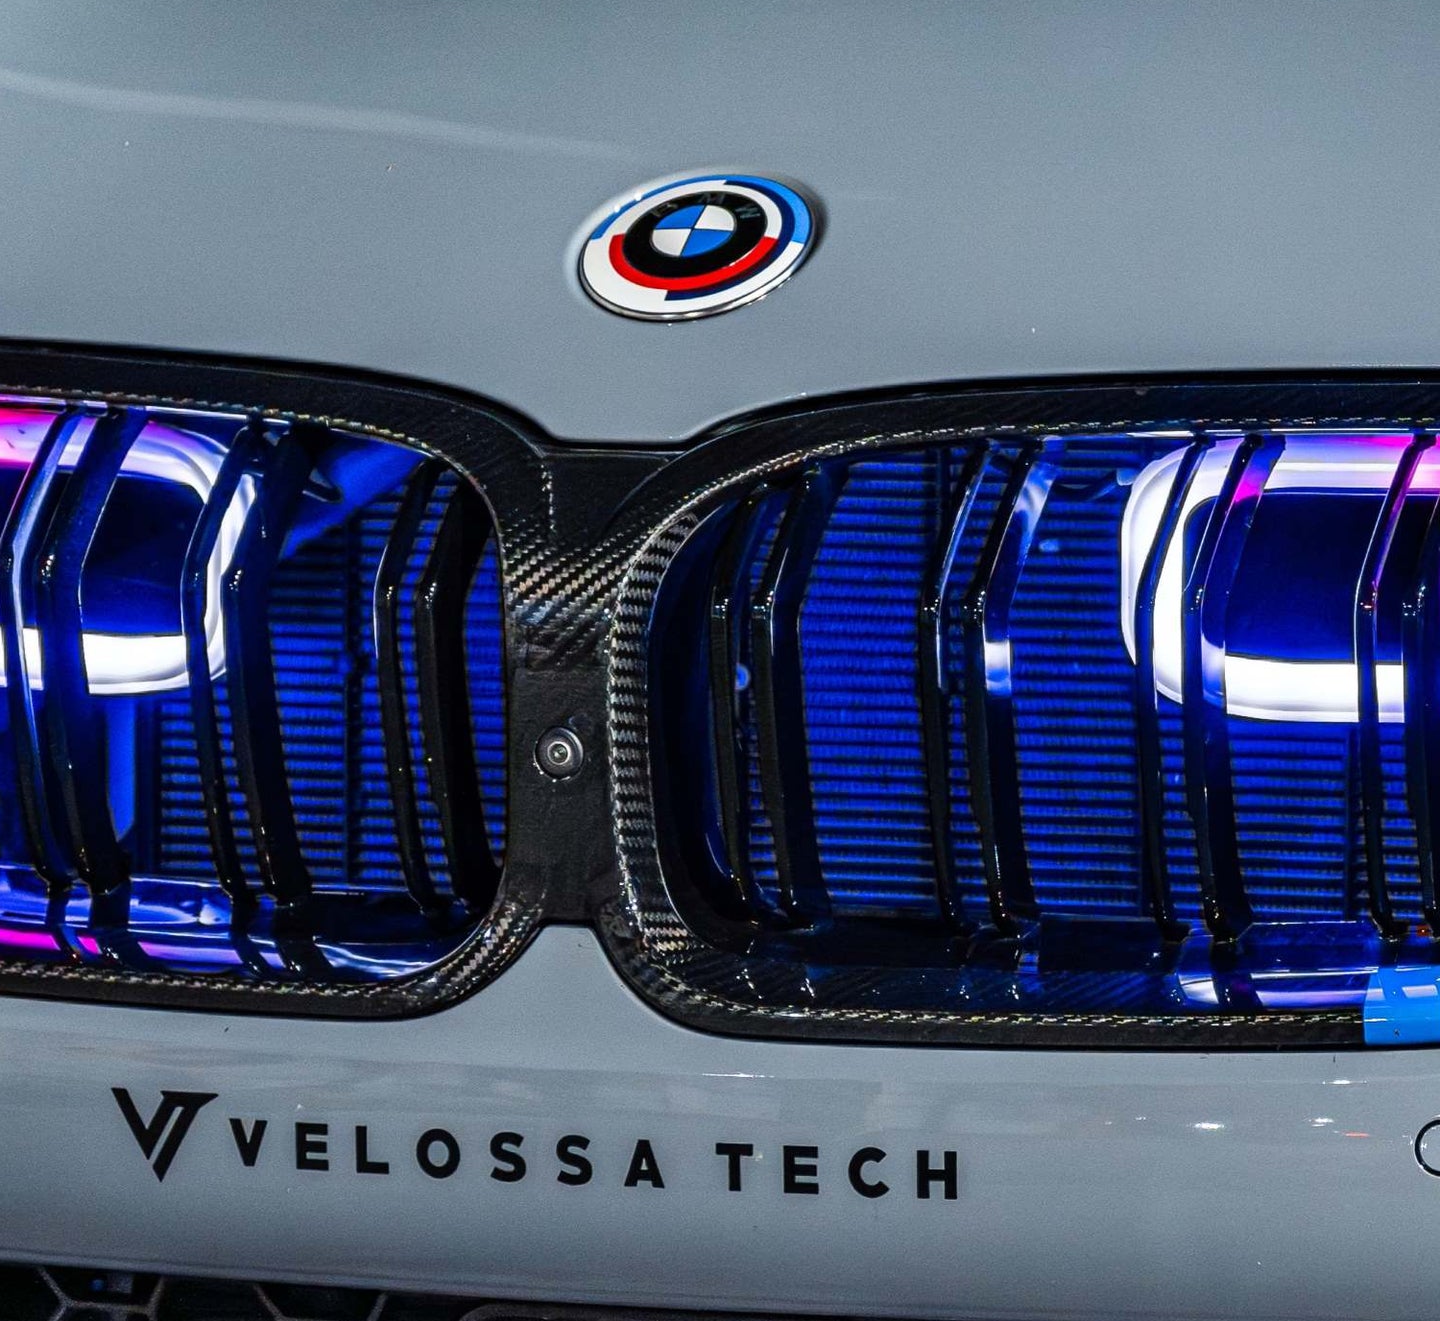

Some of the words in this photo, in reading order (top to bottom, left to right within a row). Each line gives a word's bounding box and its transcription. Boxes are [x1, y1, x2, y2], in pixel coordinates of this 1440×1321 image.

[650, 191, 762, 220] BMW
[228, 1117, 665, 1189] VELOSSA
[715, 1142, 958, 1200] TECH
